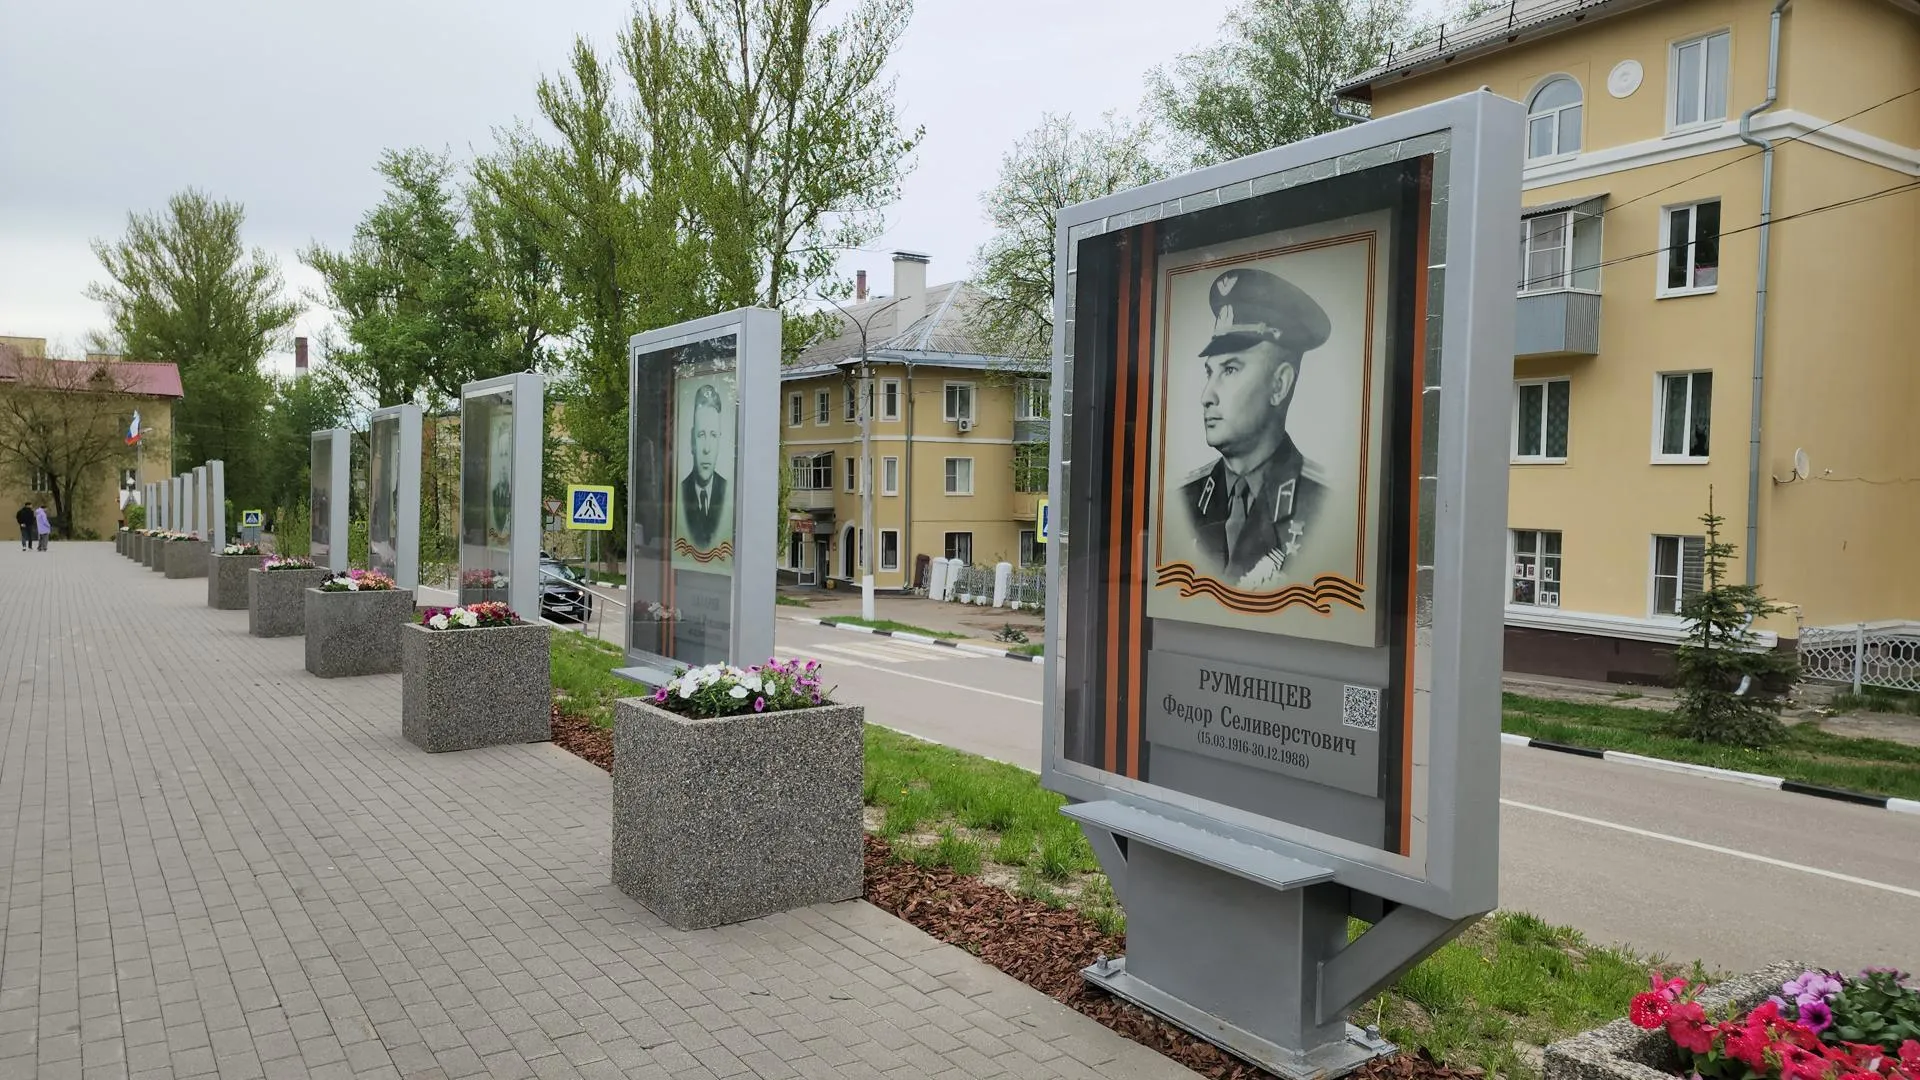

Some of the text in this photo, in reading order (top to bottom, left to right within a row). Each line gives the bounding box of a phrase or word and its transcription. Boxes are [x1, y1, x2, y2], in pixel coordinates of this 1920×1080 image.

[1199, 669, 1312, 710] РУМЯНЦЕВ
[1163, 694, 1356, 756] Федор Селиверстович
[1197, 731, 1309, 769] (15.03.1916-30.12.1988)
